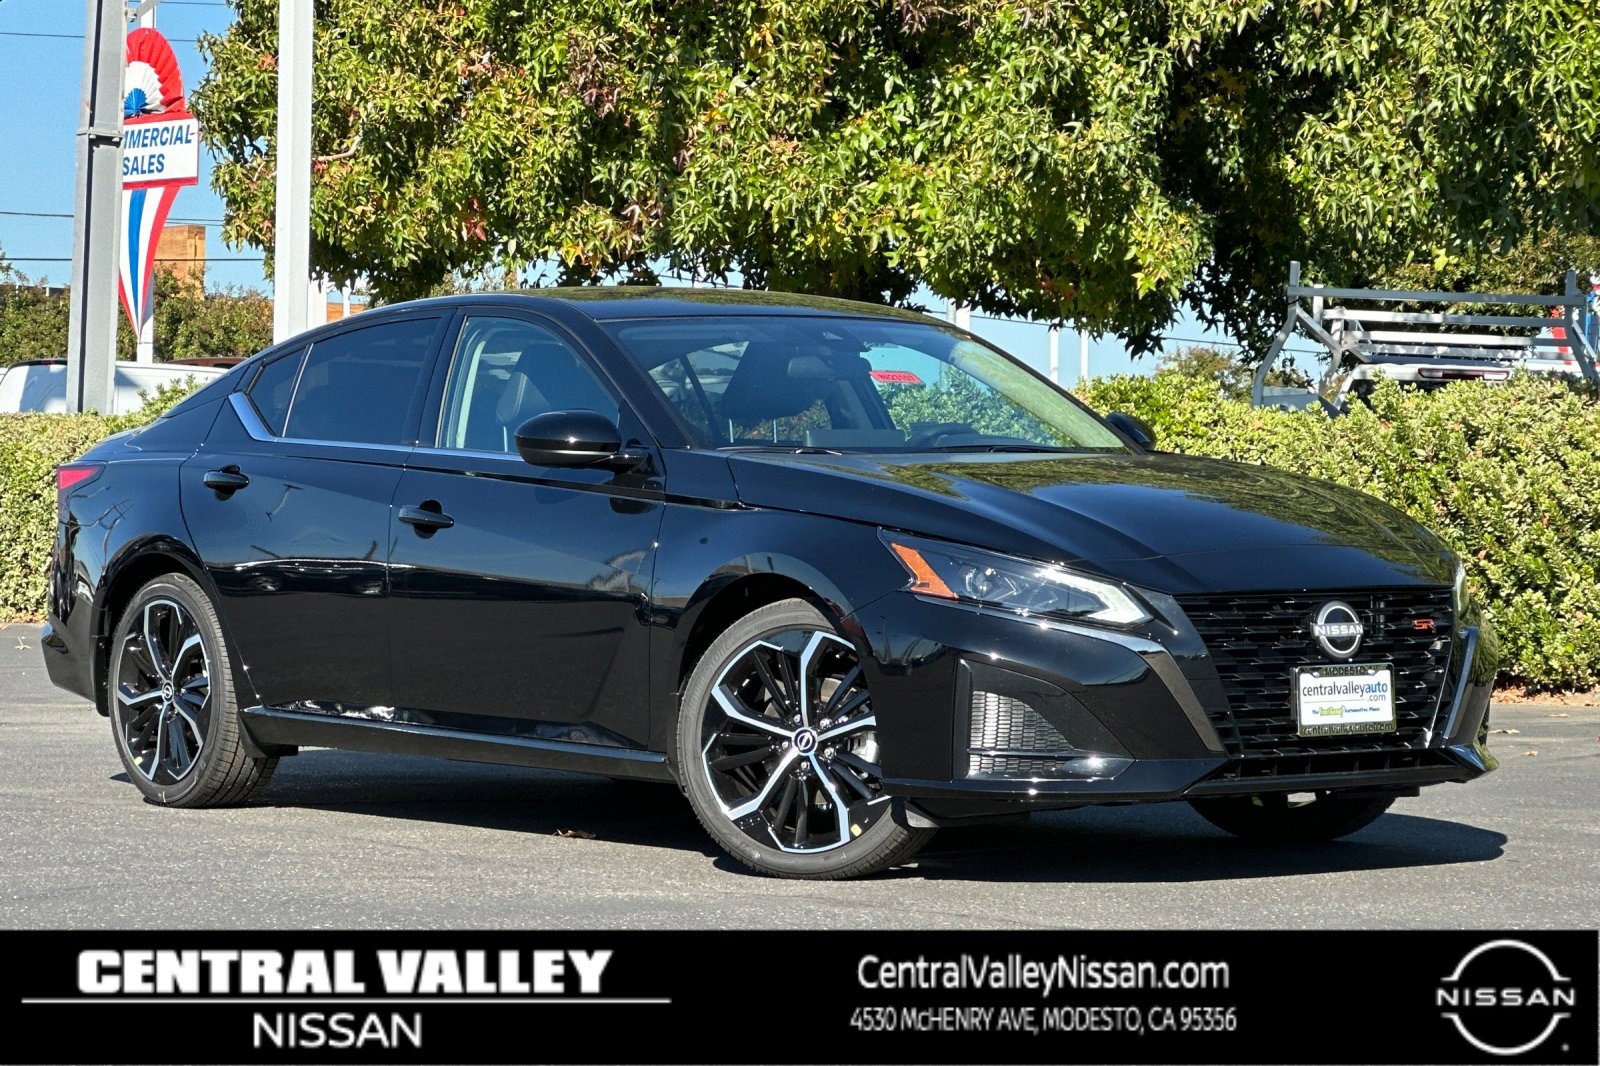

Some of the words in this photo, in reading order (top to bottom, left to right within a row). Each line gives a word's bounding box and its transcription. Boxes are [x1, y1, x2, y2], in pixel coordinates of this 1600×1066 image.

[123, 153, 165, 176] SALES
[1314, 624, 1364, 636] NISSAN
[1412, 618, 1435, 630] SR
[1324, 665, 1366, 676] MODESTO
[1302, 681, 1388, 697] centralvalleyauto
